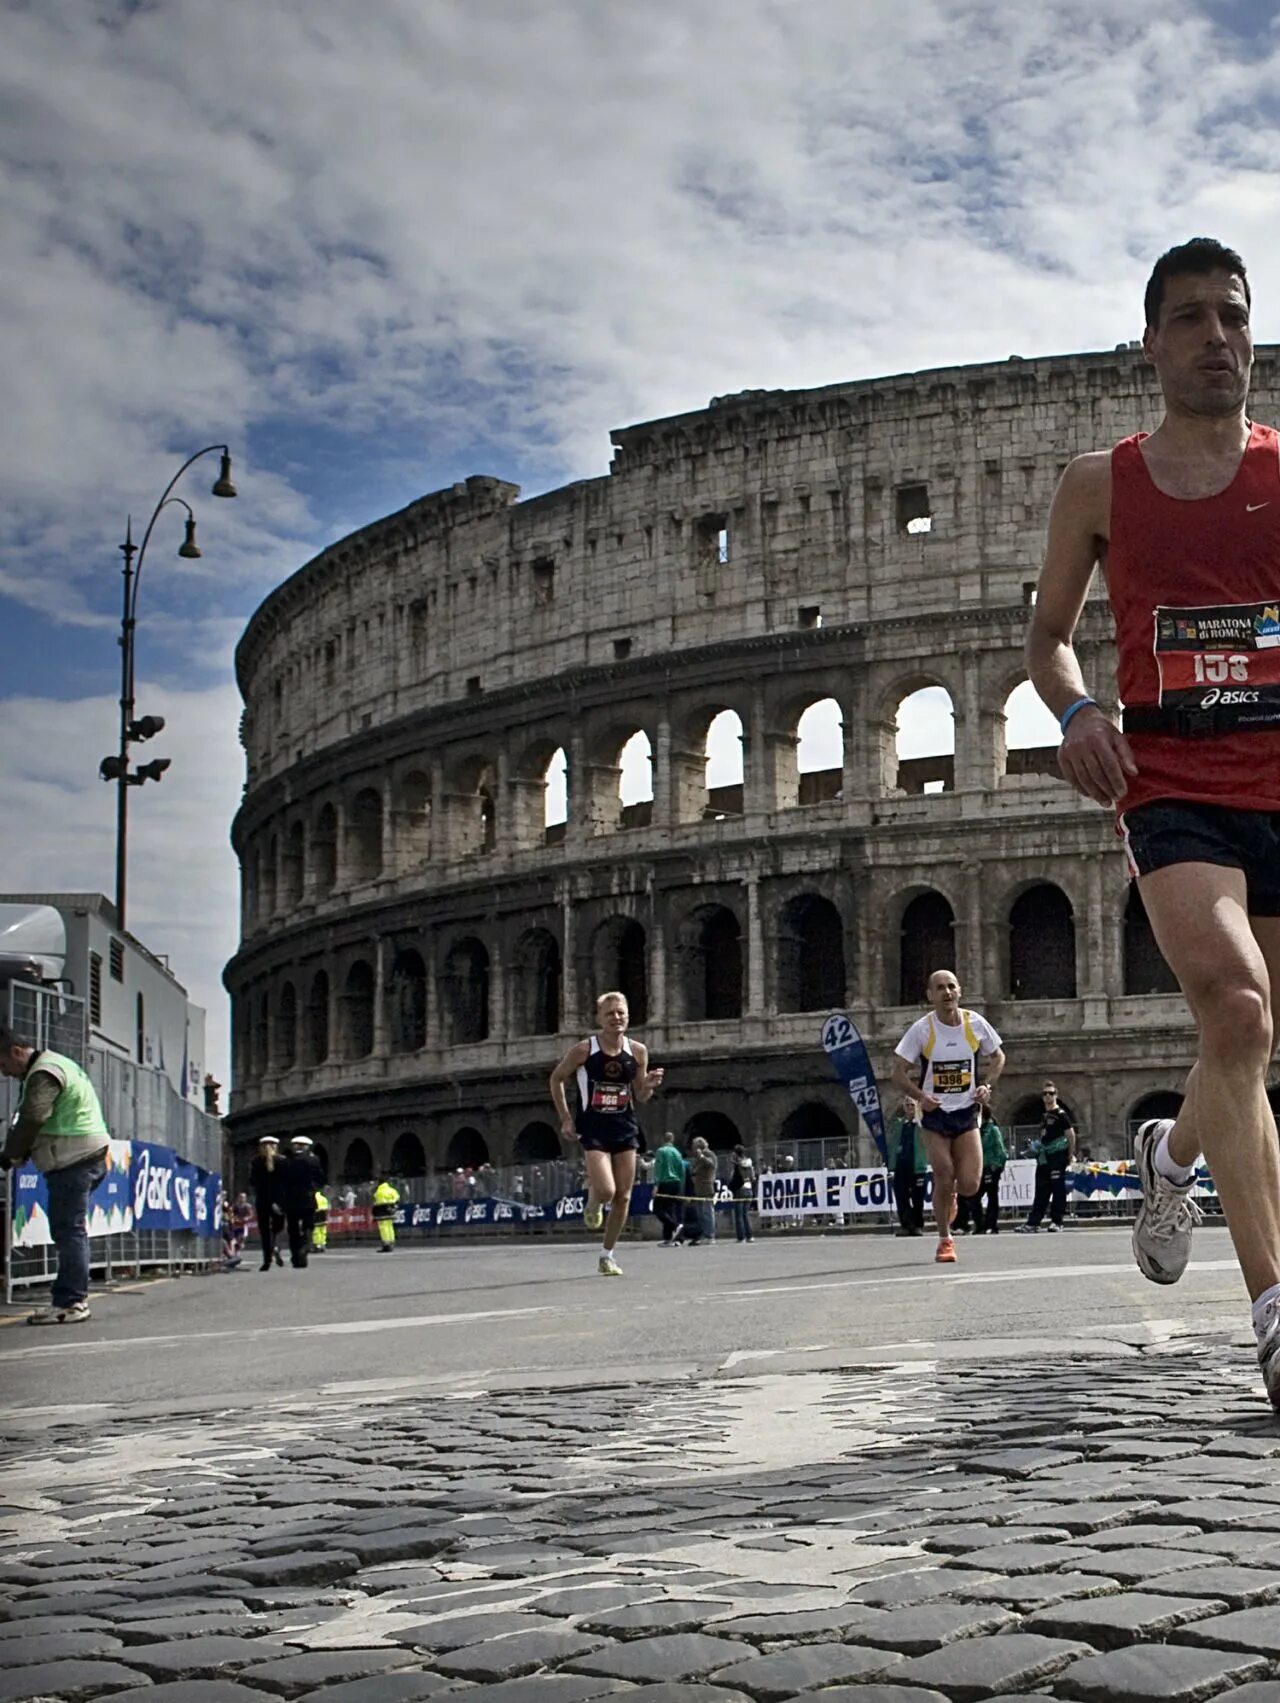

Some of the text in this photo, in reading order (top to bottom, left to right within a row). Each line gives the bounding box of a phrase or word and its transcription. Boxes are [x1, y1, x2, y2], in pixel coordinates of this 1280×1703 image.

[1198, 618, 1251, 630] MARATONA
[1199, 629, 1210, 639] di
[1211, 628, 1240, 638] ROMA
[1220, 690, 1259, 704] asics
[824, 1020, 852, 1047] 42
[939, 1074, 962, 1085] 1398
[856, 1088, 876, 1107] 42
[762, 1178, 818, 1210] ROMA
[826, 1176, 846, 1207] E'
